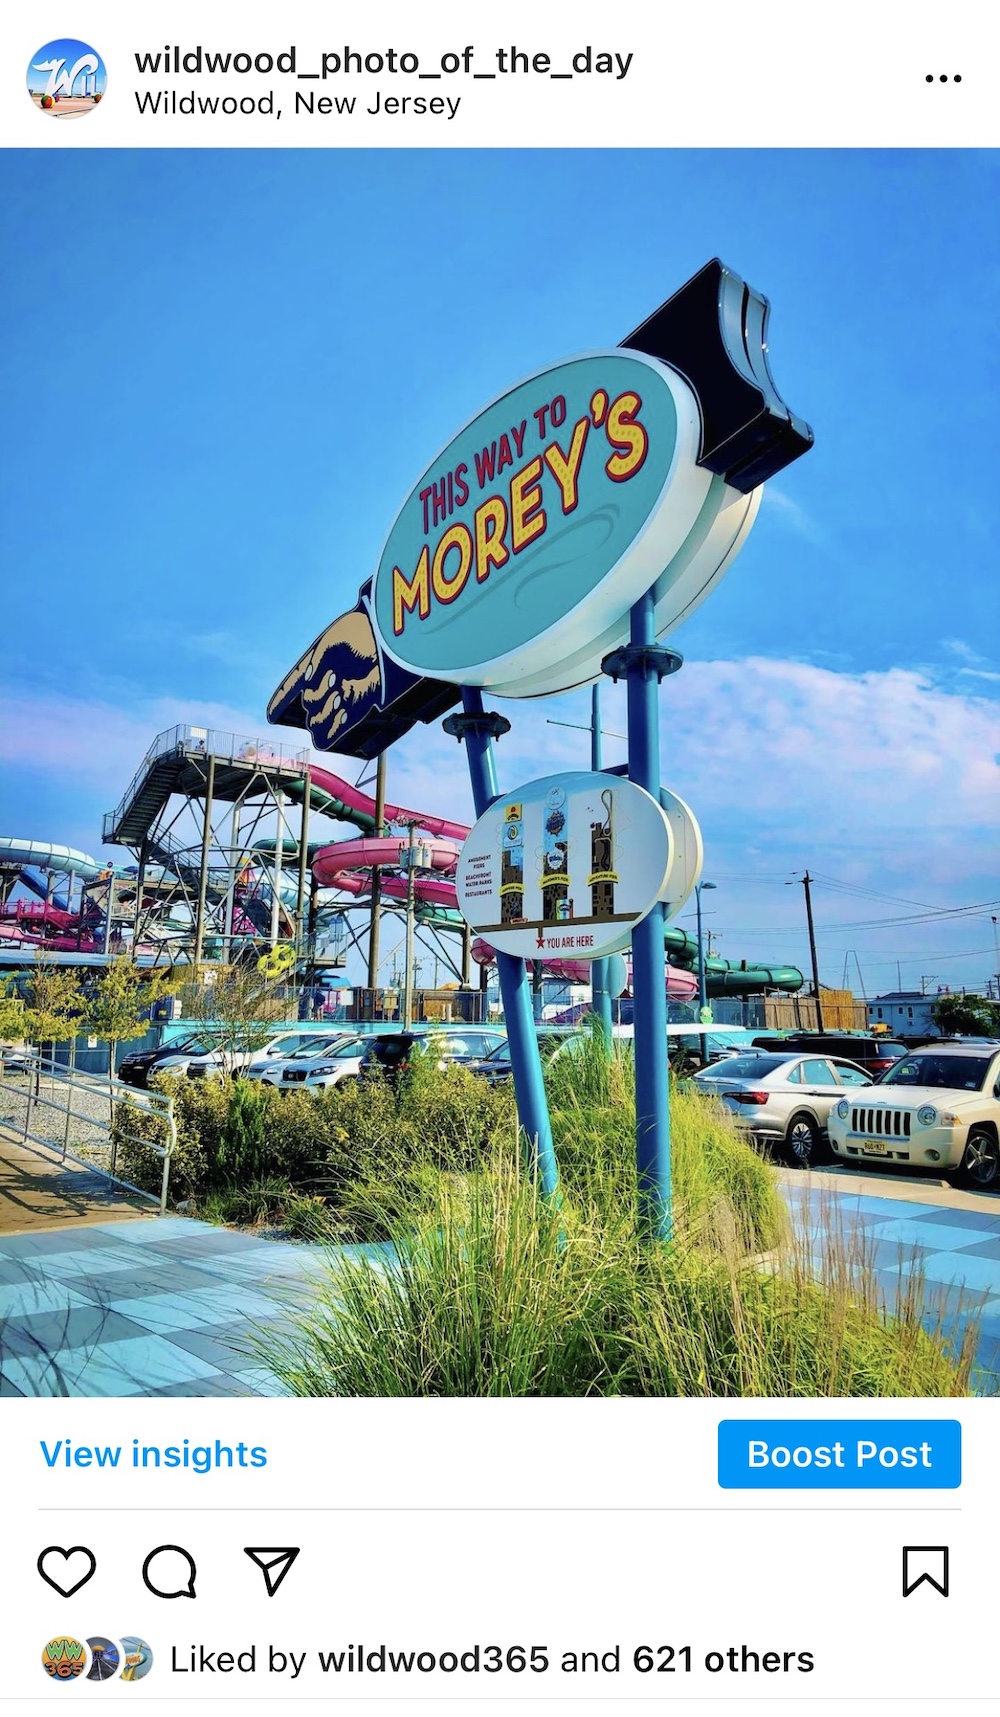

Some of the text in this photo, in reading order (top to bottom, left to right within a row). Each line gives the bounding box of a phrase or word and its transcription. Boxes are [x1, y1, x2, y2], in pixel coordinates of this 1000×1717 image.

[419, 395, 567, 535] THIS WAY TO
[392, 388, 649, 637] MOREY'S
[464, 889, 493, 897] RESTAURANTS
[546, 935, 594, 949] YOU ARE HERE
